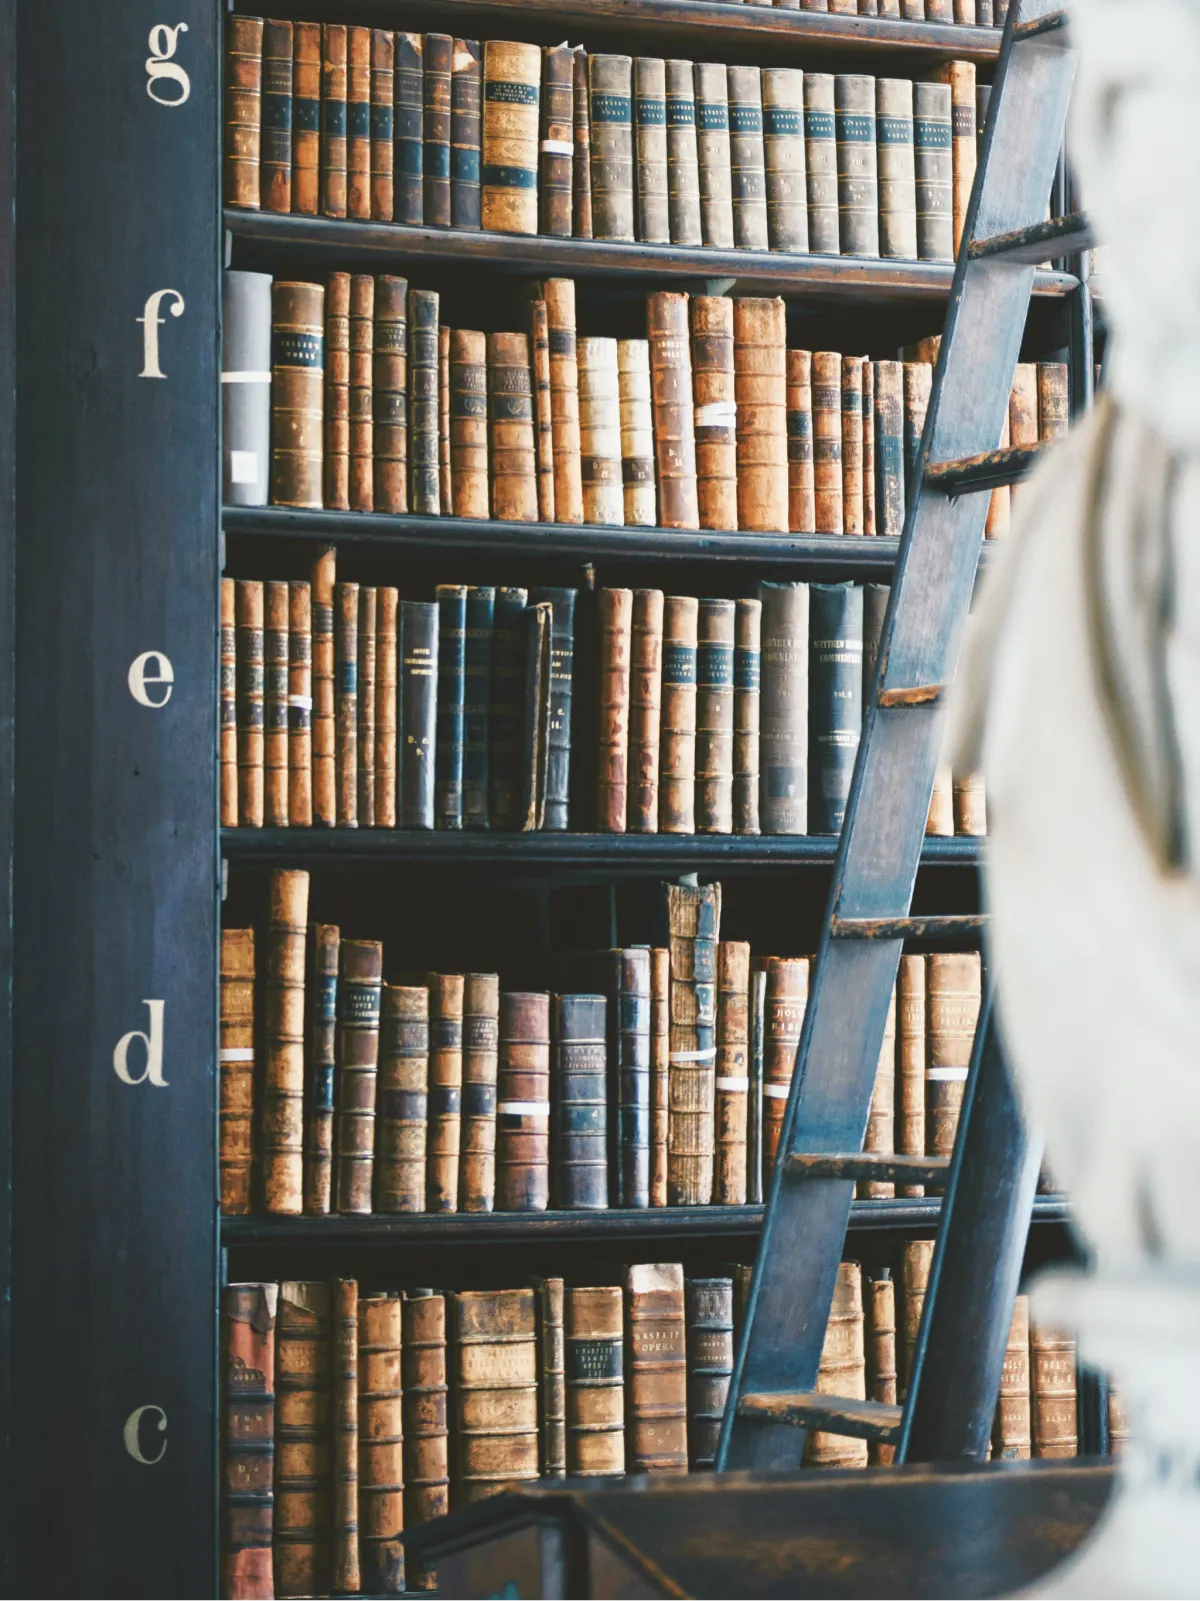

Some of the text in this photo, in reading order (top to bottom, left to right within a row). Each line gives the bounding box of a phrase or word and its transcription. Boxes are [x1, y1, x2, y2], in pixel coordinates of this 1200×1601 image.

[145, 22, 191, 107] g
[136, 288, 185, 379] f
[285, 351, 316, 361] WORKS
[127, 650, 175, 709] e
[113, 998, 169, 1087] d
[642, 1343, 674, 1352] OPERA
[123, 1404, 168, 1465] c
